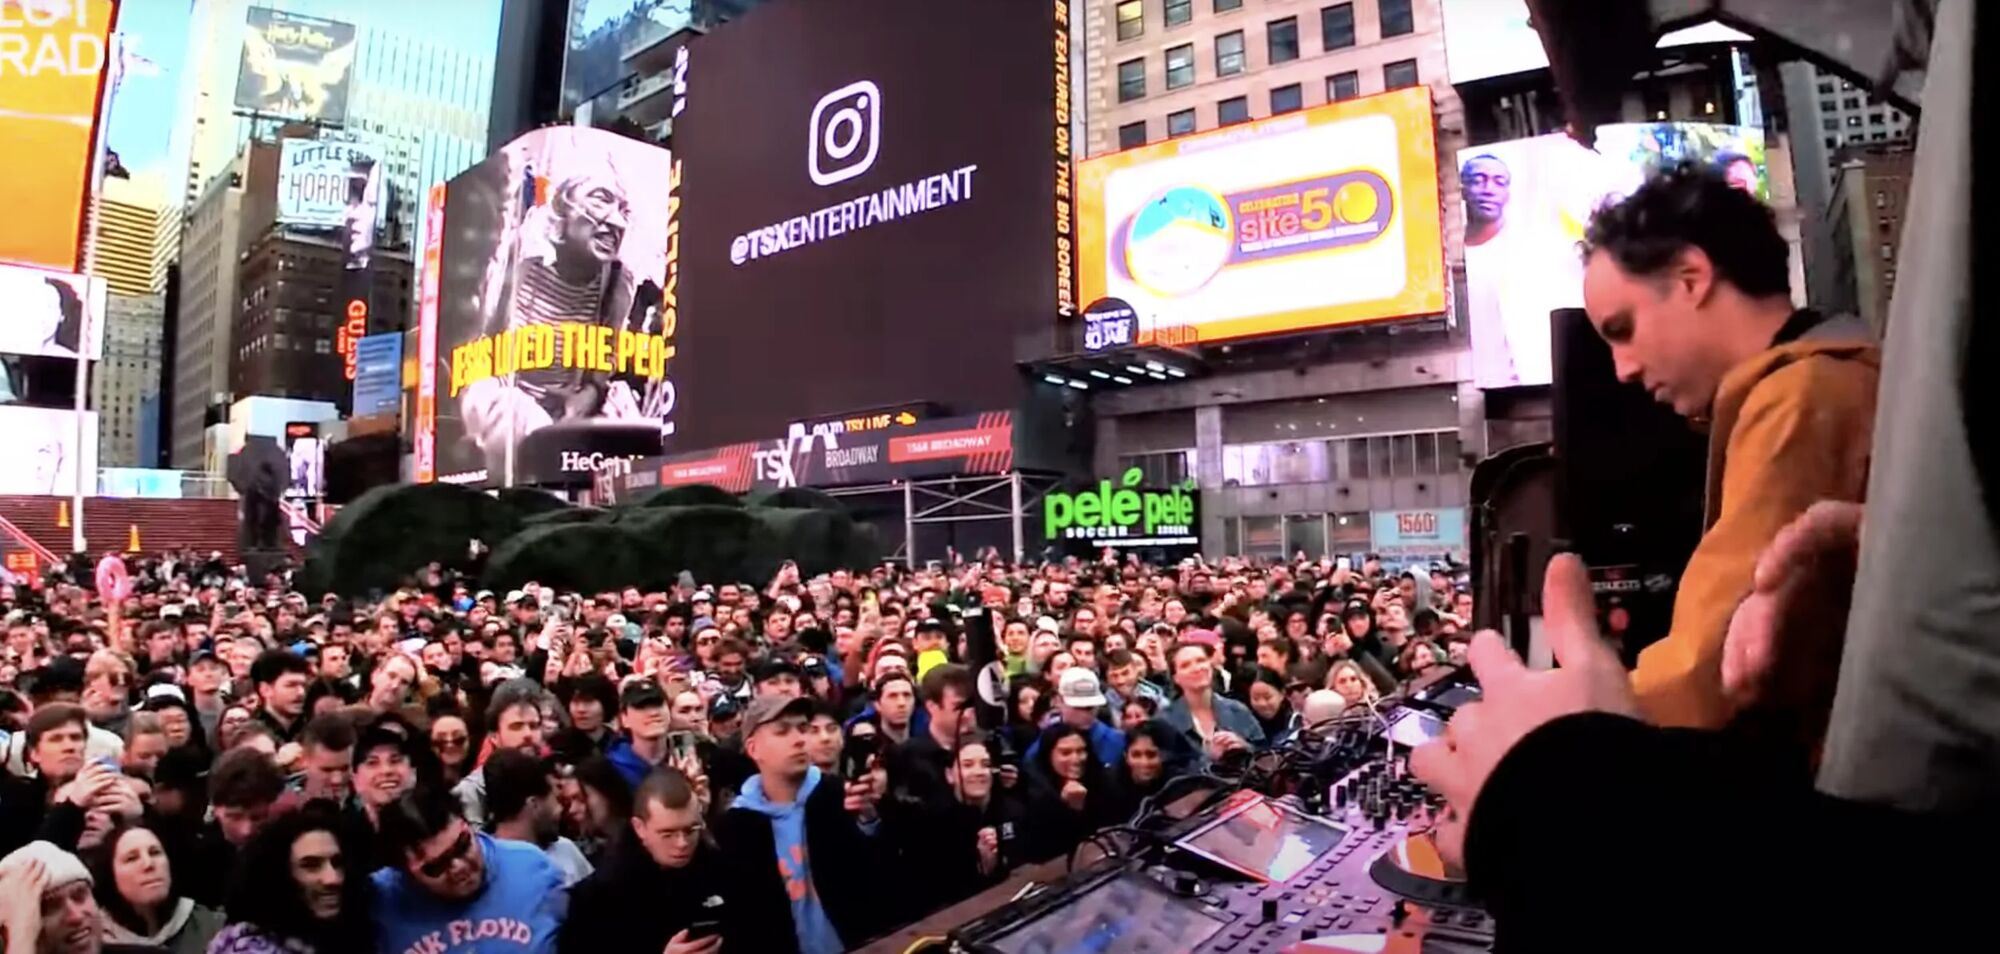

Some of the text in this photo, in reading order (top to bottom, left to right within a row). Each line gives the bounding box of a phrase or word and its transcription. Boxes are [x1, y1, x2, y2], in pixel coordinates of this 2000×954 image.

[1056, 30, 1069, 124] FEATURED
[293, 147, 342, 167] LITTLE
[1056, 127, 1069, 155] ON
[1056, 160, 1069, 198] THE
[730, 165, 977, 265] @TSXENTERTAINMENT
[559, 322, 614, 372] THE
[752, 440, 879, 488] TSX BROADWAY
[1045, 467, 1143, 539] pelé
[1144, 478, 1196, 534] pelé
[1396, 512, 1434, 533] 1560
[1065, 526, 1128, 539] SOCCER
[448, 917, 531, 945] FLOYD
